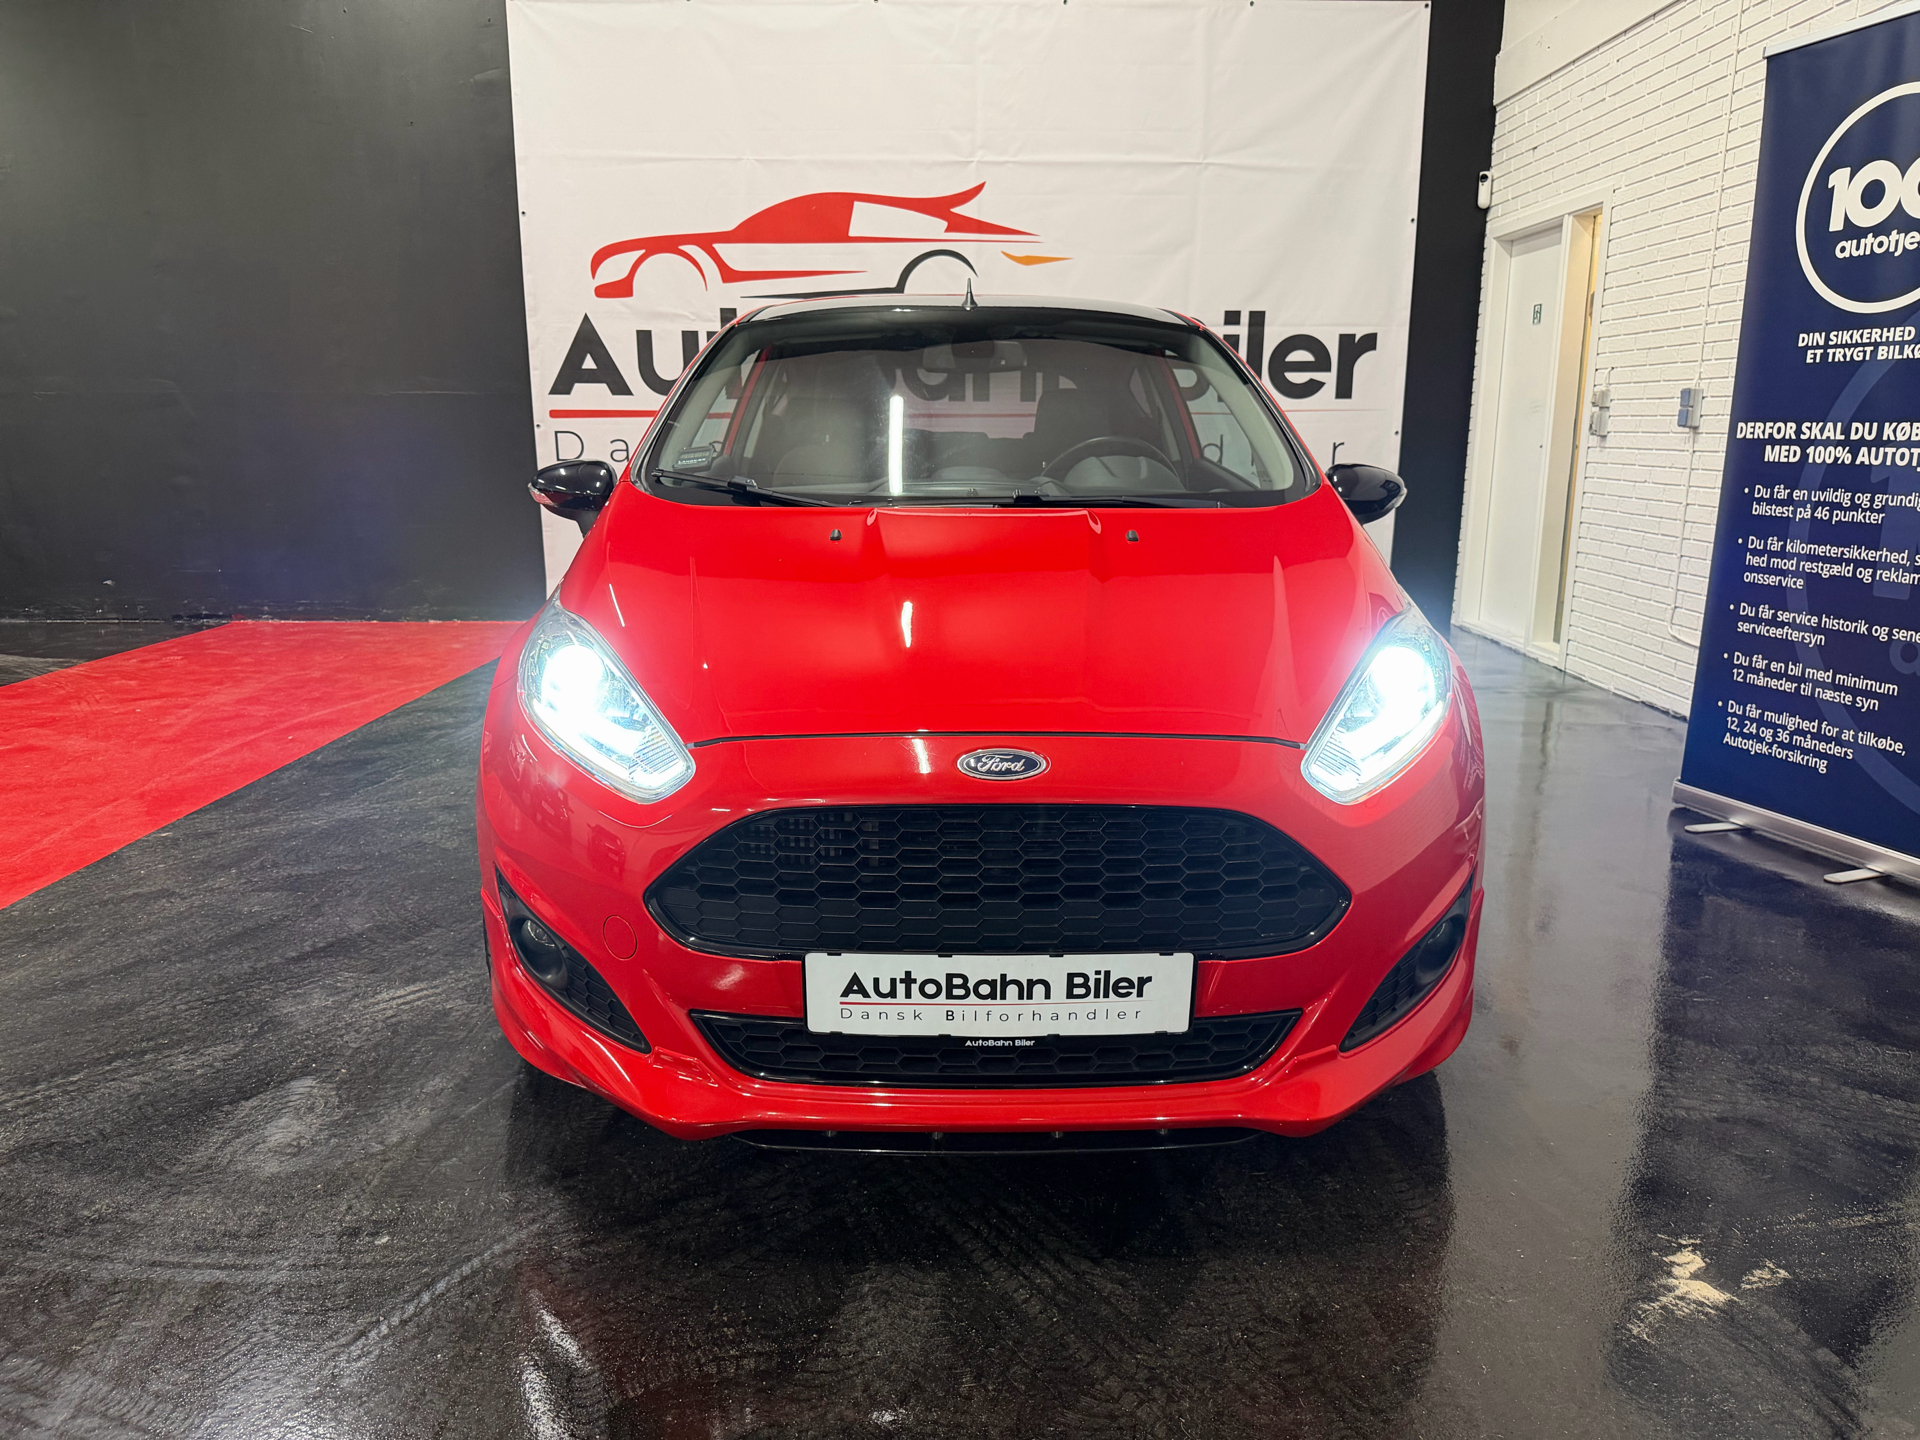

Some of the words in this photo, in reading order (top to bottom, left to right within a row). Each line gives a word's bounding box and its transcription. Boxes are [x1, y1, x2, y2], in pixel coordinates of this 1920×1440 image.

[1835, 229, 1920, 259] autotje
[1798, 332, 1826, 347] DIN
[1828, 326, 1916, 345] SIKKERHED
[1806, 349, 1824, 364] ET
[1827, 346, 1874, 362] TRYGT
[1736, 422, 1796, 439] DERFOR
[1800, 422, 1845, 440] SKAL
[1850, 422, 1878, 440] DU
[1764, 445, 1801, 462] MED
[1806, 446, 1852, 464] 100%
[1855, 447, 1920, 472] AUTOT
[1754, 485, 1770, 498] Du
[1774, 484, 1790, 500] får
[1793, 488, 1808, 500] en
[1811, 488, 1852, 506] uvildig
[1854, 492, 1872, 508] og
[1752, 502, 1794, 518] bilstest
[1796, 504, 1811, 522] på
[1814, 506, 1830, 520] 46
[1832, 508, 1885, 524] punkter
[1748, 536, 1764, 550] Du
[1767, 536, 1784, 552] får
[1786, 539, 1911, 567] kilometersikkerhed,
[1744, 572, 1804, 590] onsservice
[1746, 552, 1768, 568] hed
[1770, 557, 1796, 570] mod
[1800, 560, 1854, 578] restgæld
[1856, 566, 1874, 584] og
[1737, 620, 1826, 648] serviceeftersyn
[1740, 602, 1755, 617] Du
[1758, 604, 1774, 620] får
[1777, 610, 1818, 626] service
[1822, 614, 1868, 635] historik
[1872, 625, 1890, 642] og
[1734, 652, 1750, 666] Du
[1752, 654, 1768, 670] får
[1770, 661, 1784, 674] en
[1788, 662, 1802, 676] bil
[1805, 669, 1833, 683] med
[1836, 673, 1898, 696] minimum
[1732, 668, 1744, 682] 12
[1746, 672, 1798, 693] måneder
[1800, 682, 1812, 696] til
[1815, 686, 1852, 705] næste
[1856, 696, 1879, 712] syn
[1726, 716, 1740, 732] 12,
[1743, 720, 1758, 735] 24
[1759, 727, 1774, 742] og
[1776, 728, 1790, 744] 36
[1793, 735, 1854, 760] måneders
[1728, 700, 1744, 715] Du
[1746, 704, 1762, 719] får
[1764, 710, 1818, 734] mulighed
[1821, 722, 1839, 737] for
[1842, 728, 1855, 742] at
[1858, 732, 1906, 756] tilkøbe,
[977, 754, 1026, 772] Ford
[1723, 732, 1828, 774] Autotjek-forsikring
[839, 970, 1051, 1000] AutoBahn
[1066, 970, 1153, 1000] Biler
[840, 1008, 923, 1021] Dansk
[945, 1008, 1142, 1022] Bilforhandler
[964, 1039, 1012, 1047] AutoBahn
[1014, 1039, 1036, 1047] Biler
